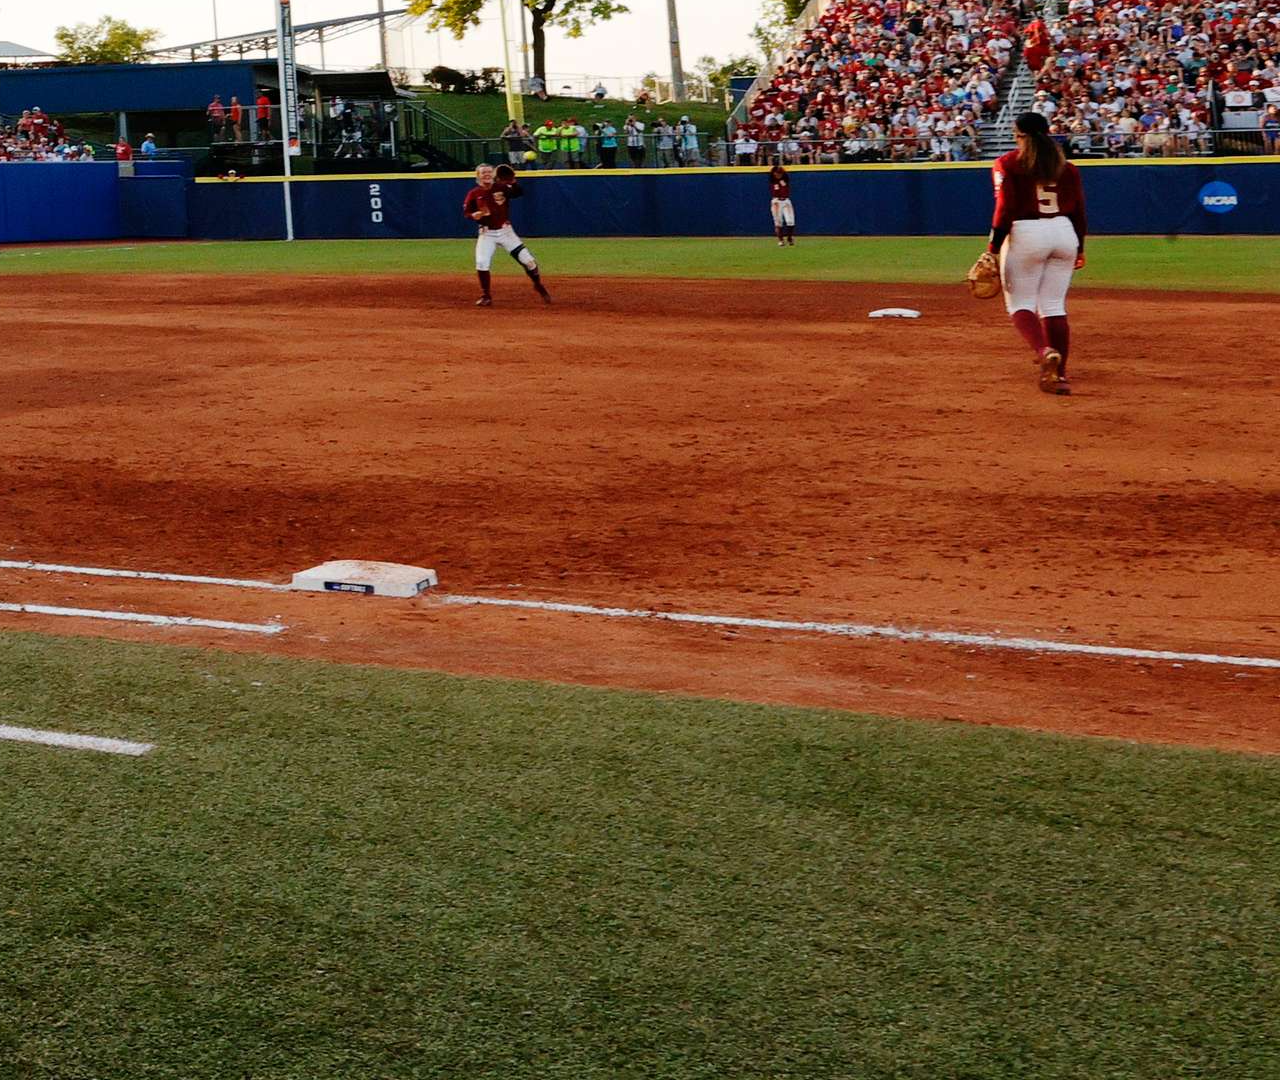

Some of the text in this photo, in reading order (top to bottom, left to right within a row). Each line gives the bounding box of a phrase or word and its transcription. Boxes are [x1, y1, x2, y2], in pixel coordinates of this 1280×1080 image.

[369, 183, 383, 222] 200
[1036, 183, 1059, 214] 5
[1202, 196, 1238, 205] NCAA
